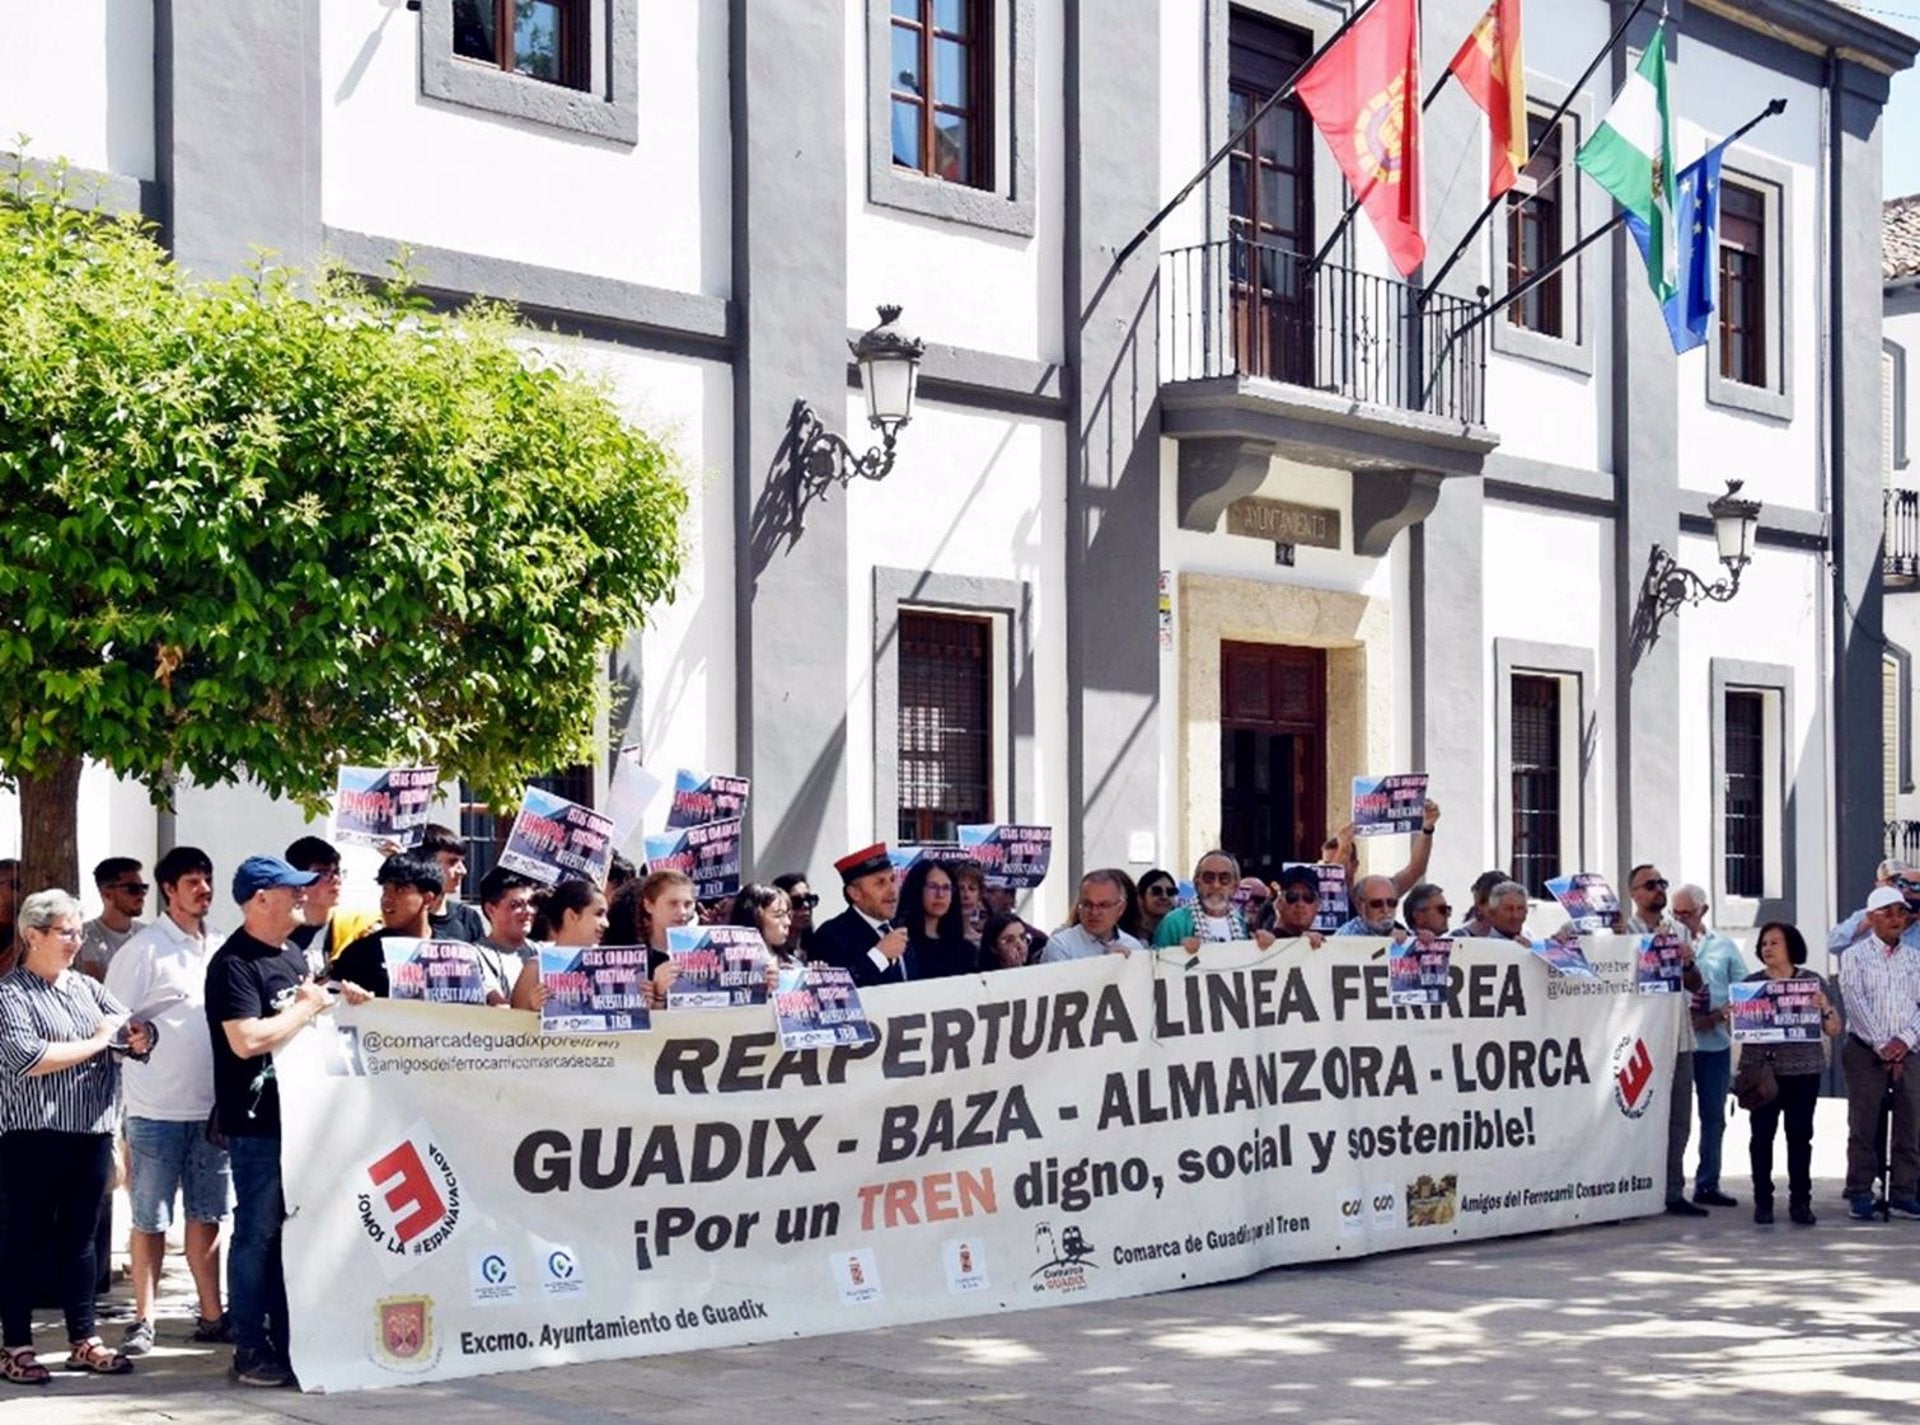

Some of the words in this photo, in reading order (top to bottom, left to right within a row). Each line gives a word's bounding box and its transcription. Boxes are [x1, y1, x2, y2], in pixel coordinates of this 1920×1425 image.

[654, 985, 1137, 1095] REAPERTURA
[1154, 956, 1319, 1039] LÍNEA
[513, 1115, 822, 1194] GUADIX
[877, 1084, 1042, 1164] BAZA
[1098, 1044, 1418, 1130] ALMANZORA
[1452, 1038, 1591, 1093] LORCA
[634, 1207, 760, 1271] ¡Por
[775, 1201, 841, 1244] un
[857, 1167, 999, 1232] TREN
[1014, 1156, 1164, 1213] digno,
[1178, 1124, 1292, 1182] social
[1309, 1129, 1337, 1173] y
[1347, 1107, 1536, 1159] sostenible!
[1461, 1193, 1502, 1215] Amigos
[1504, 1190, 1522, 1209] del
[1113, 1239, 1181, 1265] Comarca
[1185, 1233, 1202, 1252] de
[1276, 1215, 1310, 1234] Tren
[460, 1332, 534, 1355] Excmo.
[539, 1311, 671, 1349] Ayuntamiento
[675, 1308, 699, 1327] de
[702, 1299, 769, 1326] Guadix
